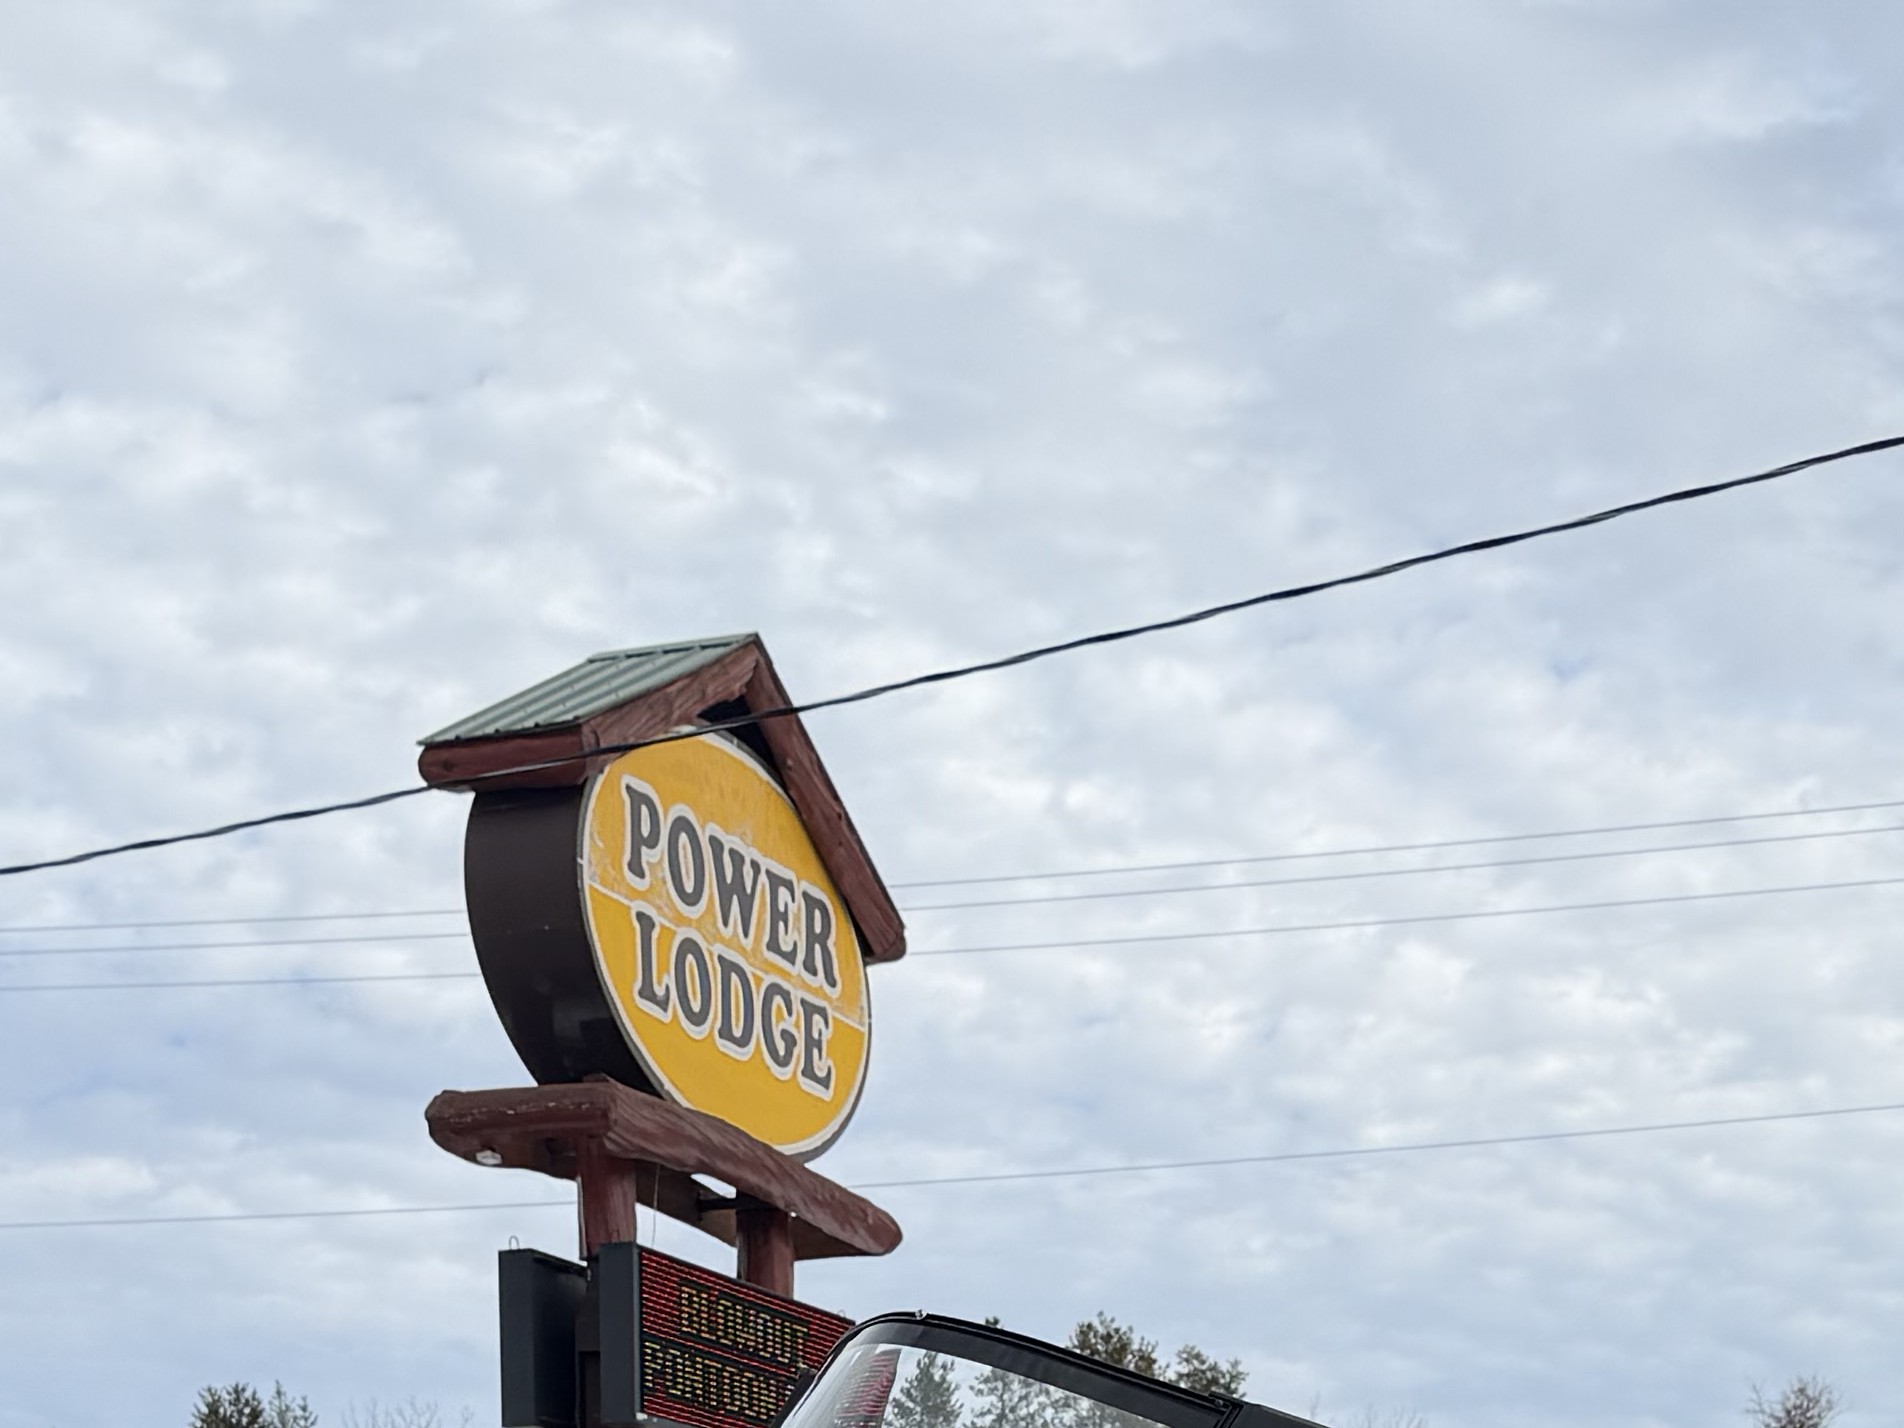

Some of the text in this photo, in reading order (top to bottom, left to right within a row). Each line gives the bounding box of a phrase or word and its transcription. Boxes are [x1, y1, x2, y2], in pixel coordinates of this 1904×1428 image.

[623, 780, 839, 993] POWER
[633, 905, 833, 1096] LODGE
[680, 1285, 809, 1368] BLOWOUT
